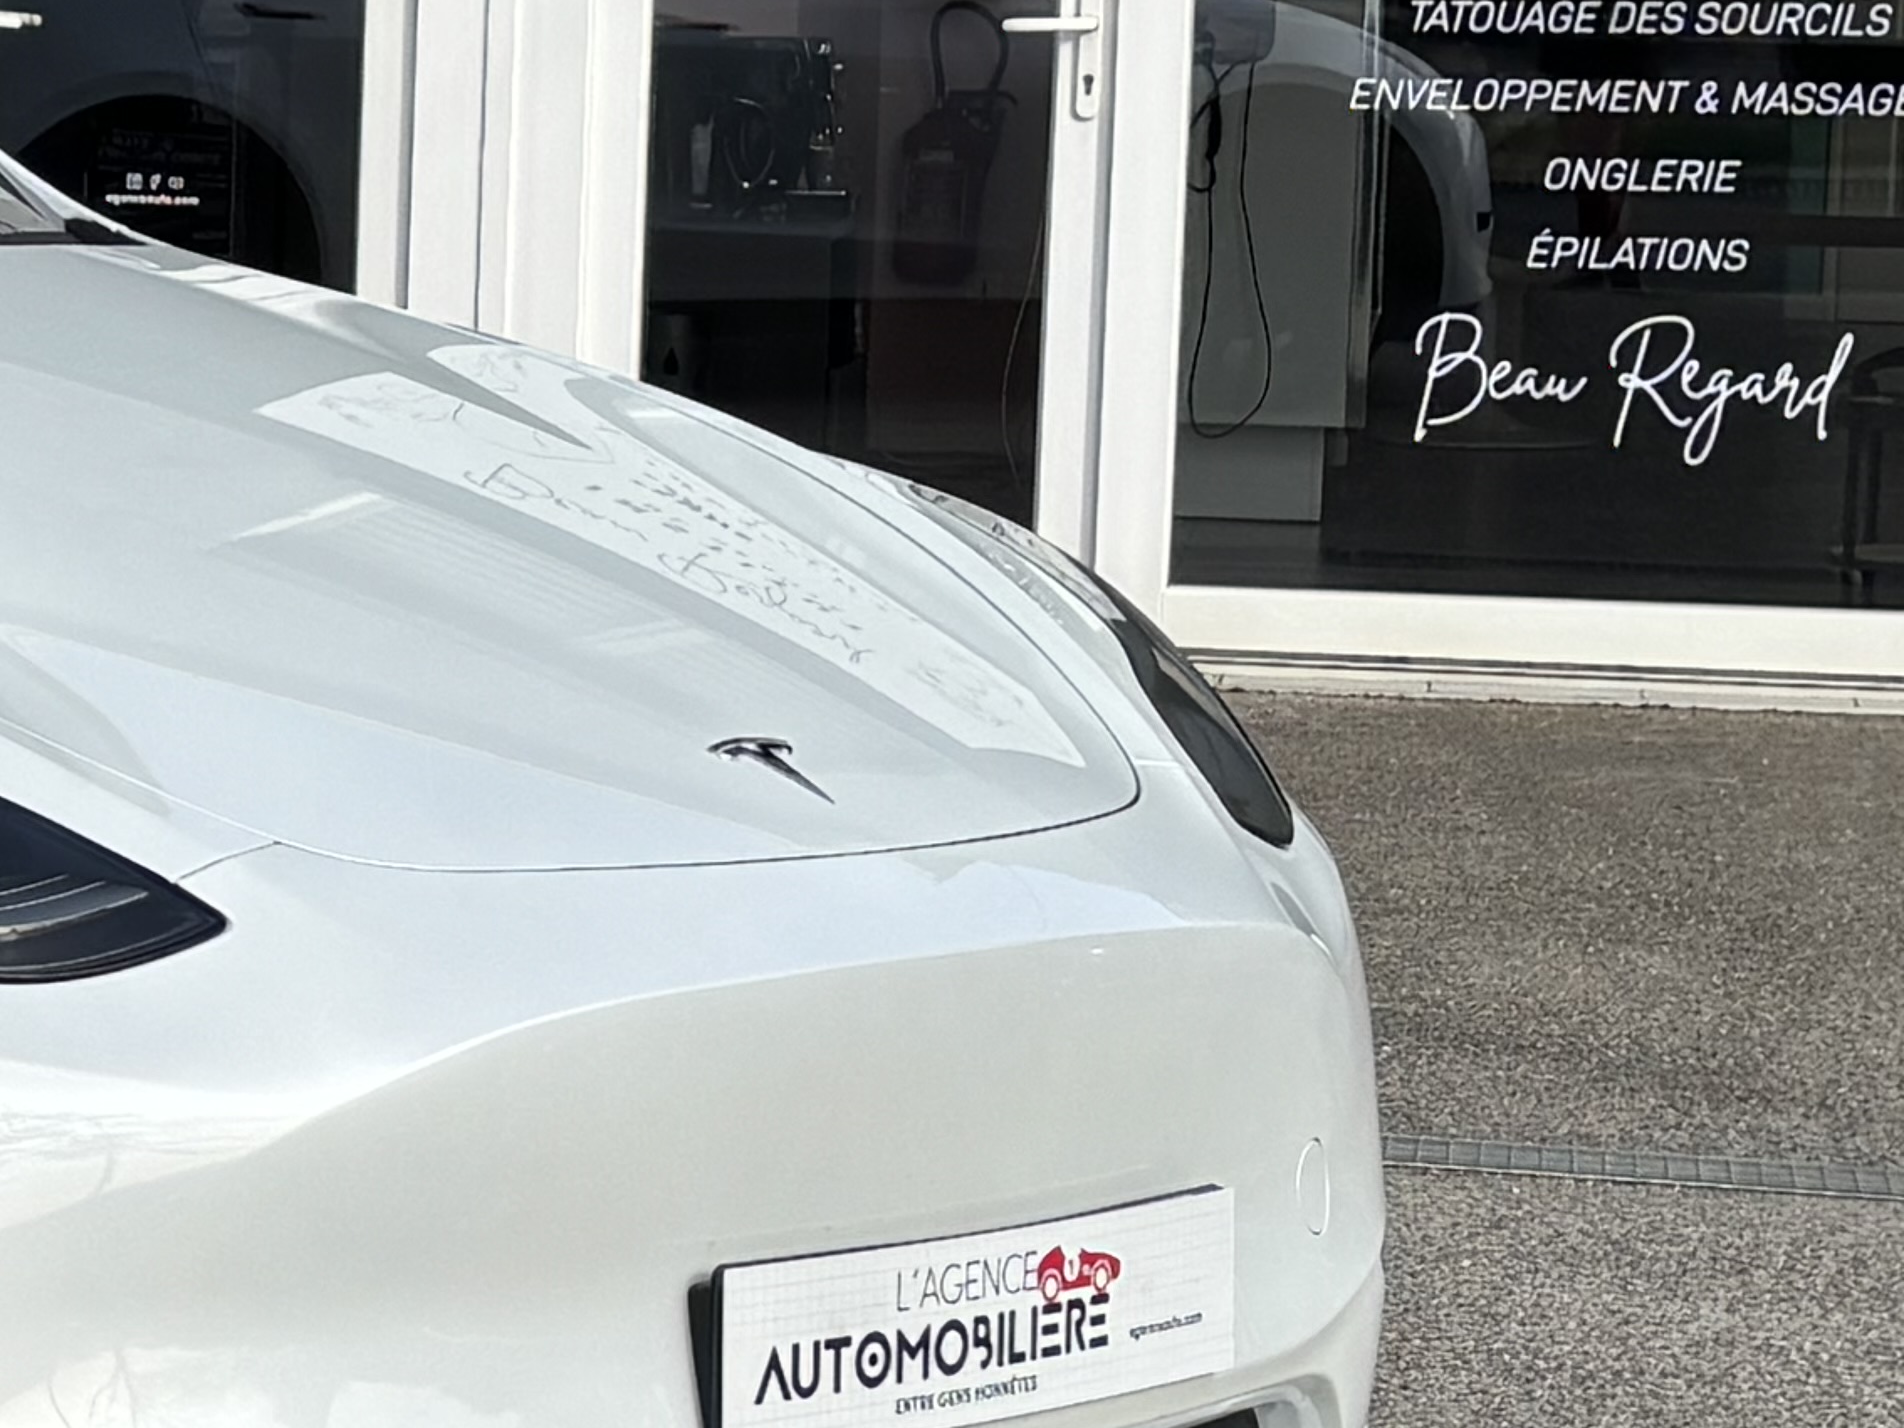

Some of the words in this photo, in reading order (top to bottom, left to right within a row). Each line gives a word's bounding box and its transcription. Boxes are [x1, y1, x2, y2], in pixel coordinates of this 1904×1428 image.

[1410, 0, 1600, 34] TATOUAGE
[1609, 1, 1687, 35] DES
[1694, 1, 1893, 37] SOURCILS
[1349, 77, 1690, 114] ENVELOPPEMENT
[1694, 80, 1722, 115] &
[1543, 158, 1742, 193] ONGLERIE
[1525, 228, 1752, 272] ÉPILATIONS
[1412, 310, 1588, 442] Beau
[1607, 314, 1855, 466] Regard
[896, 1250, 1039, 1312] L'AGENCE
